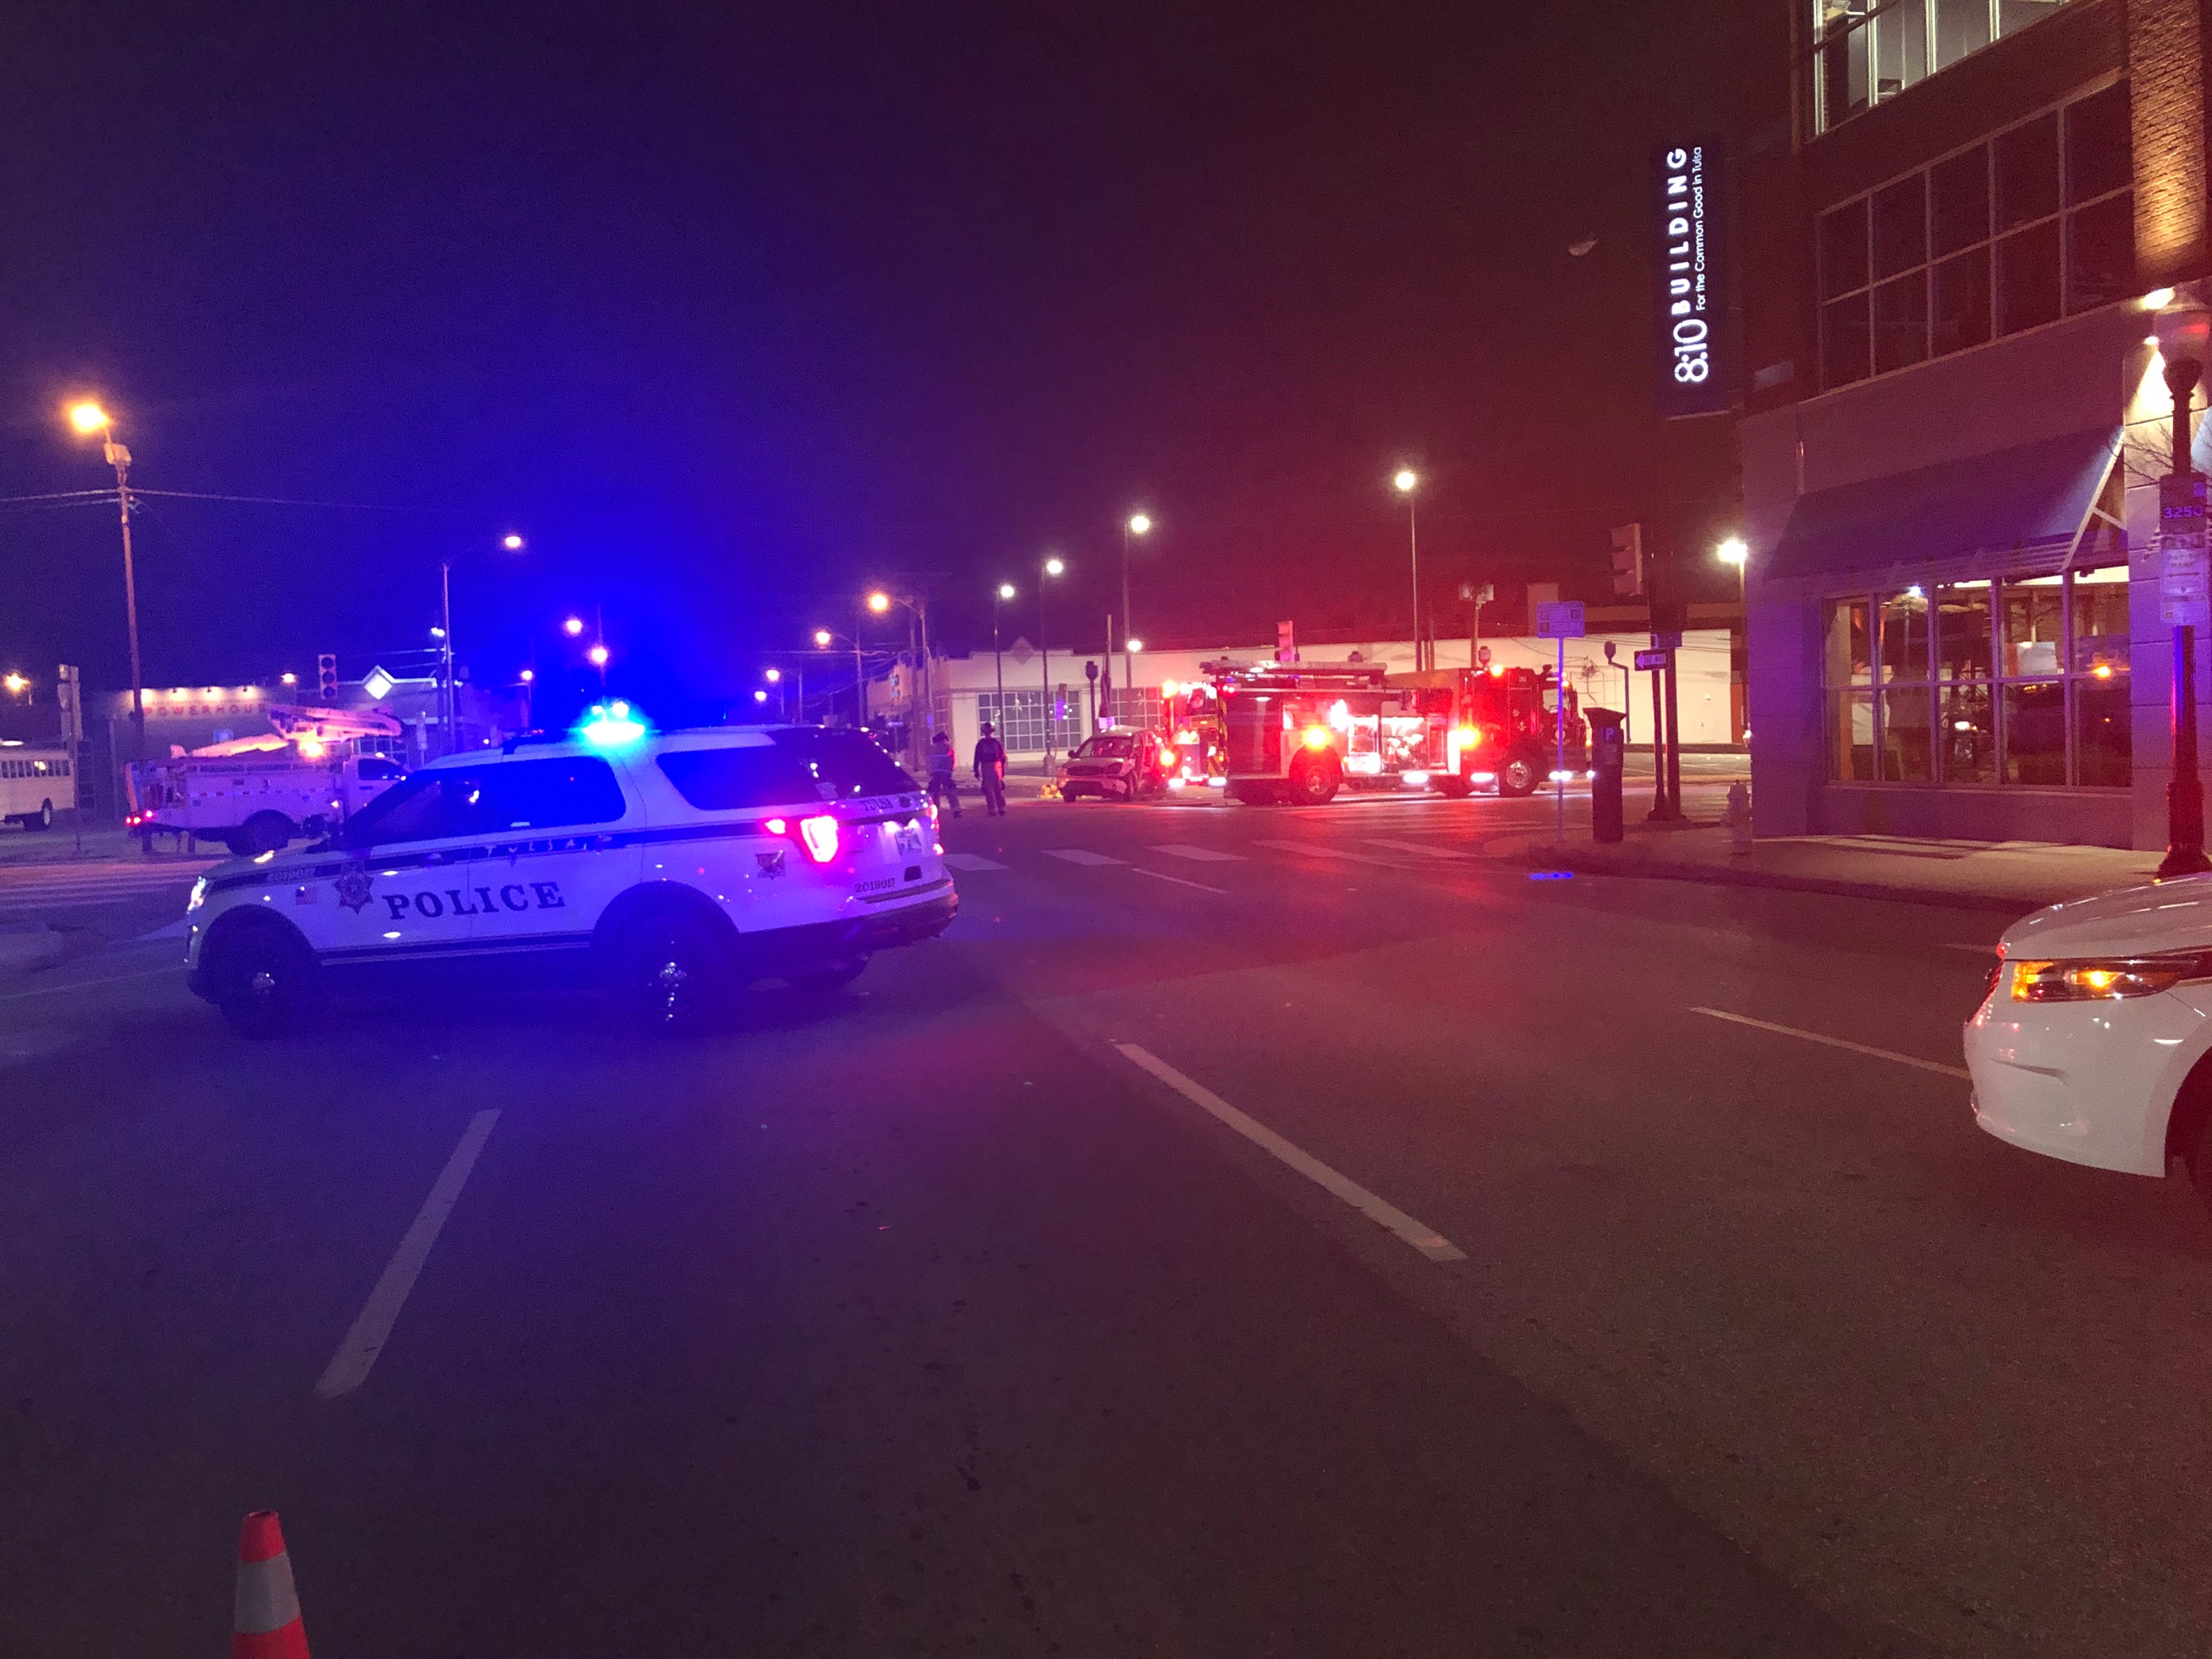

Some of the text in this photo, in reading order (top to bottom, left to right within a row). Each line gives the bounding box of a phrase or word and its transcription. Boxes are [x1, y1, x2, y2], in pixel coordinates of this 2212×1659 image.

[1667, 148, 1708, 382] 8:10 BUILDING
[1692, 146, 1706, 311] For the Common Good in Tulsa
[858, 798, 895, 812] TULSA
[382, 881, 567, 920] POLICE
